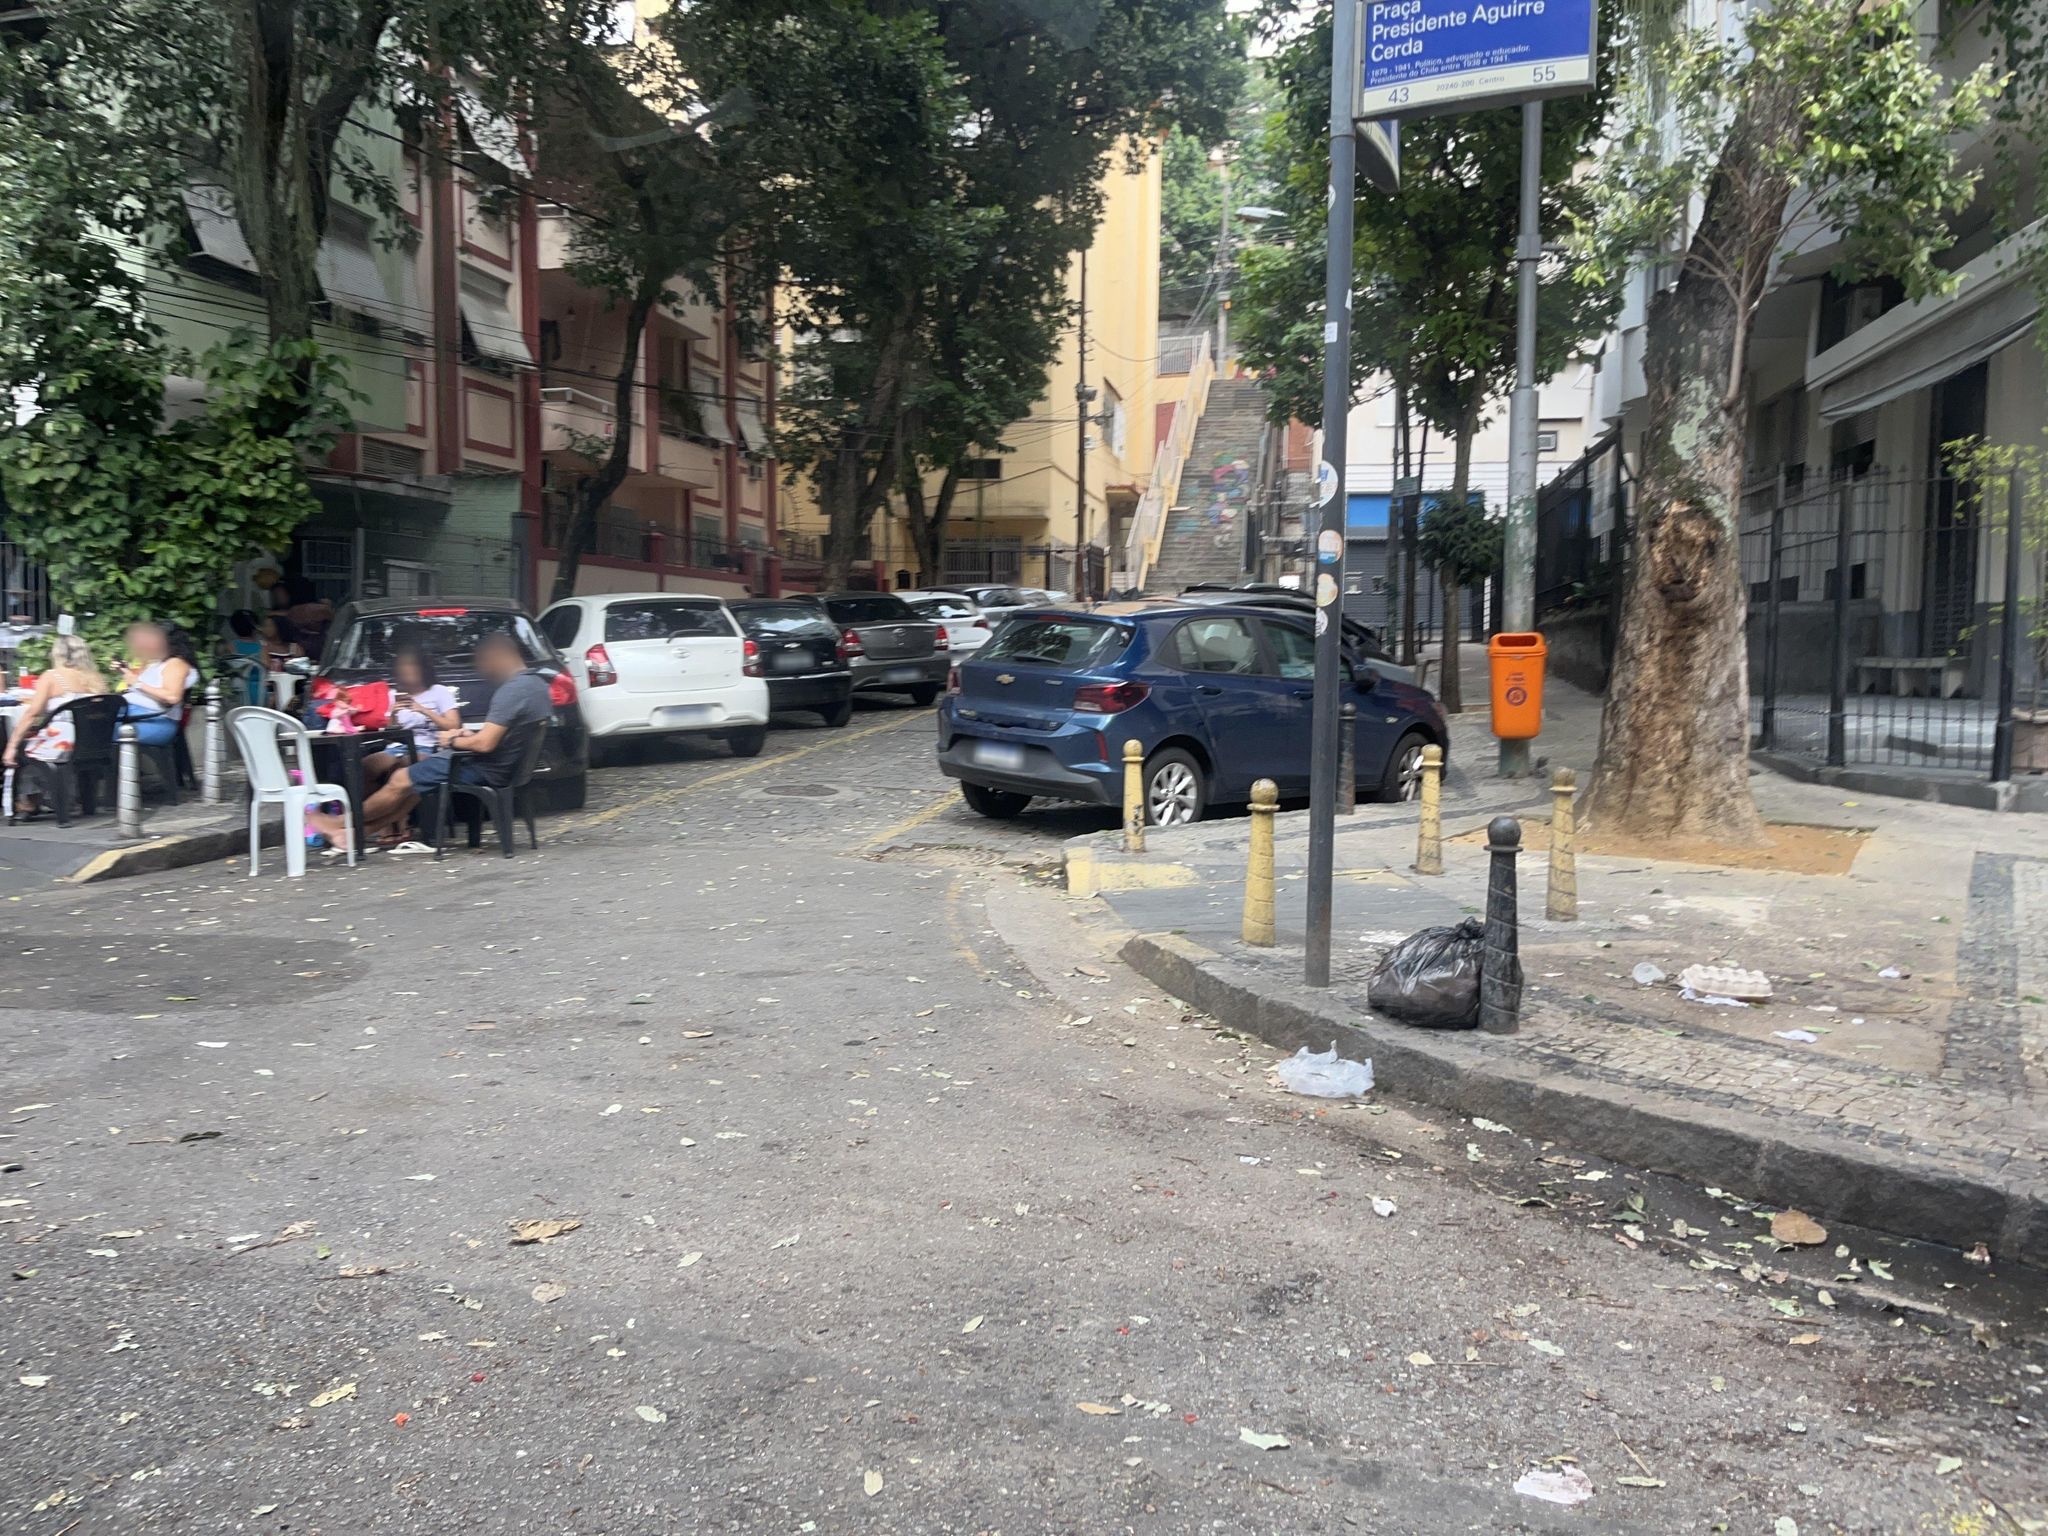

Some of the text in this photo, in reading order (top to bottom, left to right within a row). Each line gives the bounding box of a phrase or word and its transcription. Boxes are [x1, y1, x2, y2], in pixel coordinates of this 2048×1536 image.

[1372, 0, 1545, 42] Presidente Aguirre
[1373, 0, 1421, 22] Praça
[1371, 37, 1423, 62] Cerda
[1370, 73, 1407, 86] Presidente
[1440, 63, 1461, 72] entre
[1533, 65, 1556, 83] 55
[1388, 87, 1409, 104] 43
